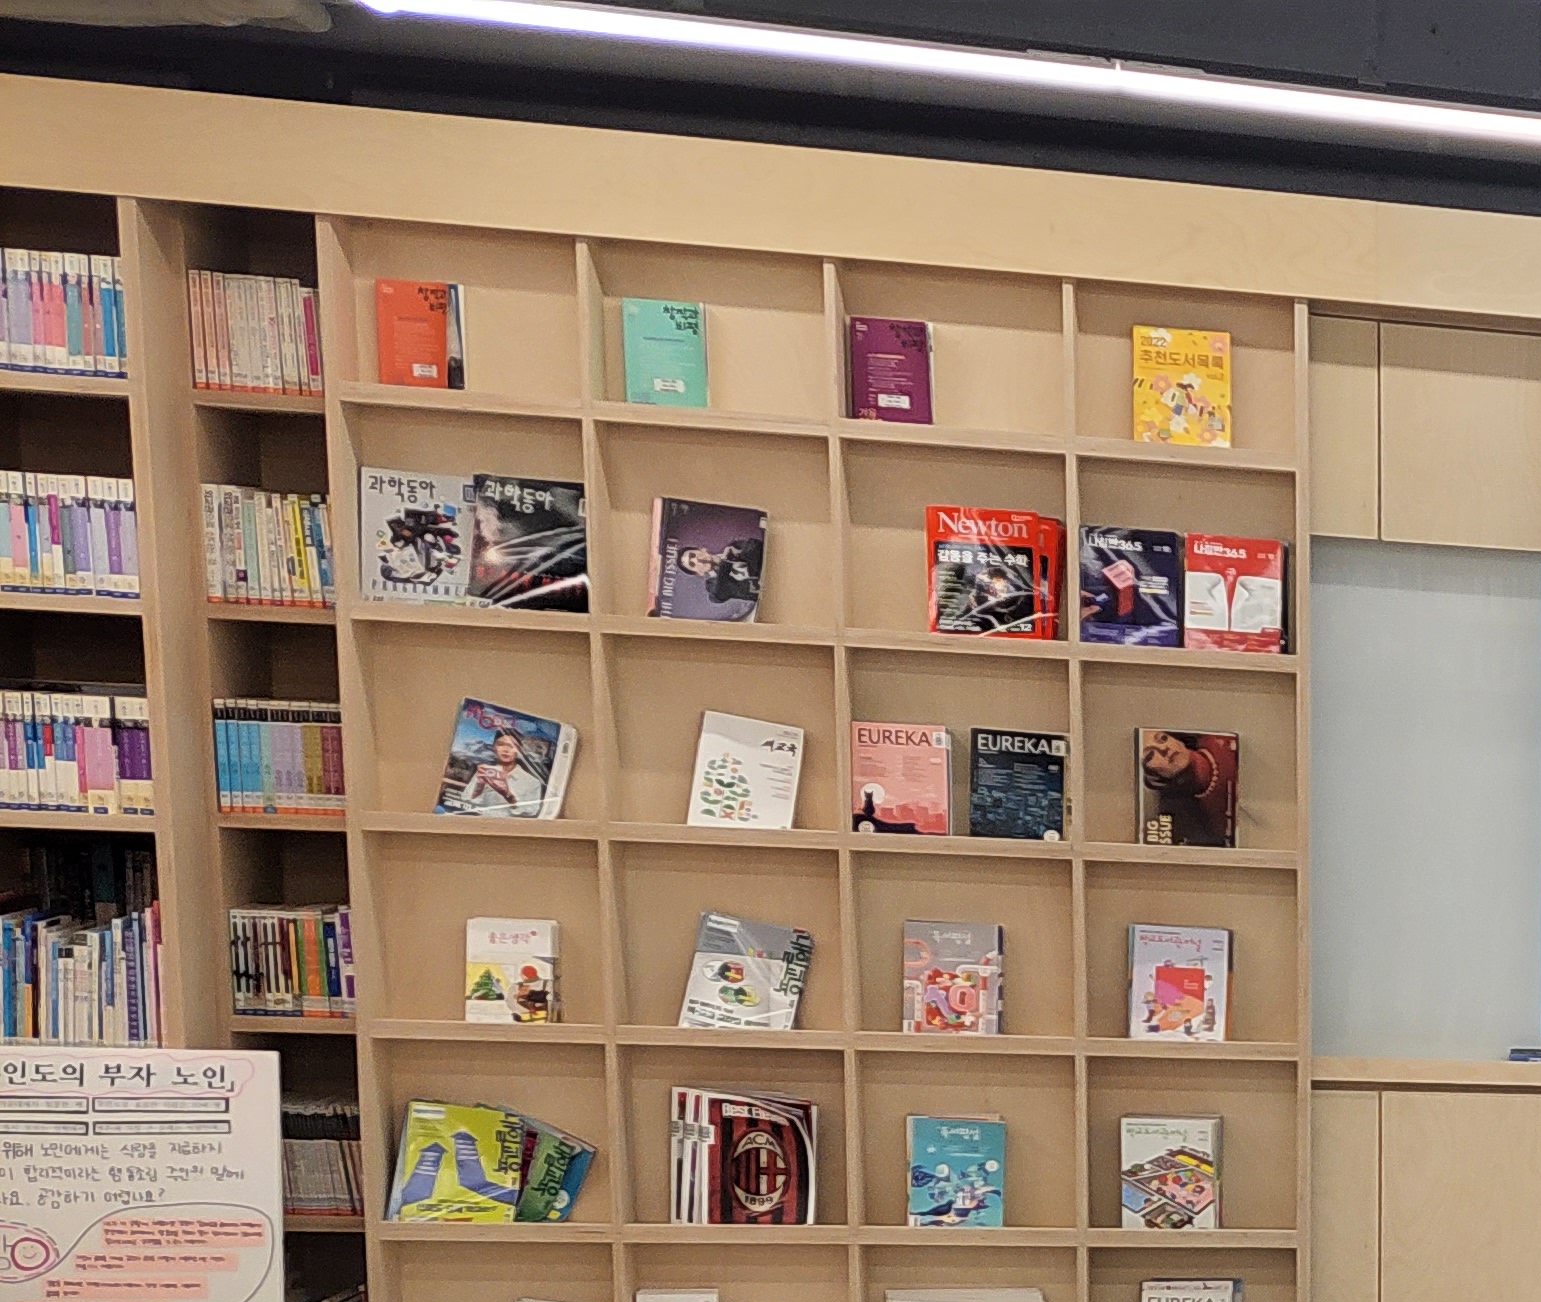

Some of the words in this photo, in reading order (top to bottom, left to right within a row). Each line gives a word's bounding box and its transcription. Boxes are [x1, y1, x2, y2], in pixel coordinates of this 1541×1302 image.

[1139, 349, 1224, 370] 추천도서목록
[368, 475, 436, 503] 과학동아
[485, 480, 554, 514] 과학동아
[936, 511, 1029, 538] Newton
[977, 551, 1002, 565] 주는
[857, 727, 932, 747] EUREKA
[977, 733, 1050, 754] EUREKA
[1146, 820, 1159, 842] BIG
[3, 1060, 85, 1088] 인도의
[98, 1063, 157, 1088] 부자
[2, 1141, 34, 1159] 위해
[41, 1143, 110, 1159] 노인에게는
[120, 1142, 156, 1159] 식량을
[168, 1141, 222, 1155] 지급하지
[741, 1133, 777, 1150] ACM
[166, 1165, 204, 1181] 주인의
[210, 1165, 245, 1181] 말에
[37, 1188, 96, 1210] 공감하기
[744, 1195, 774, 1207] 1899
